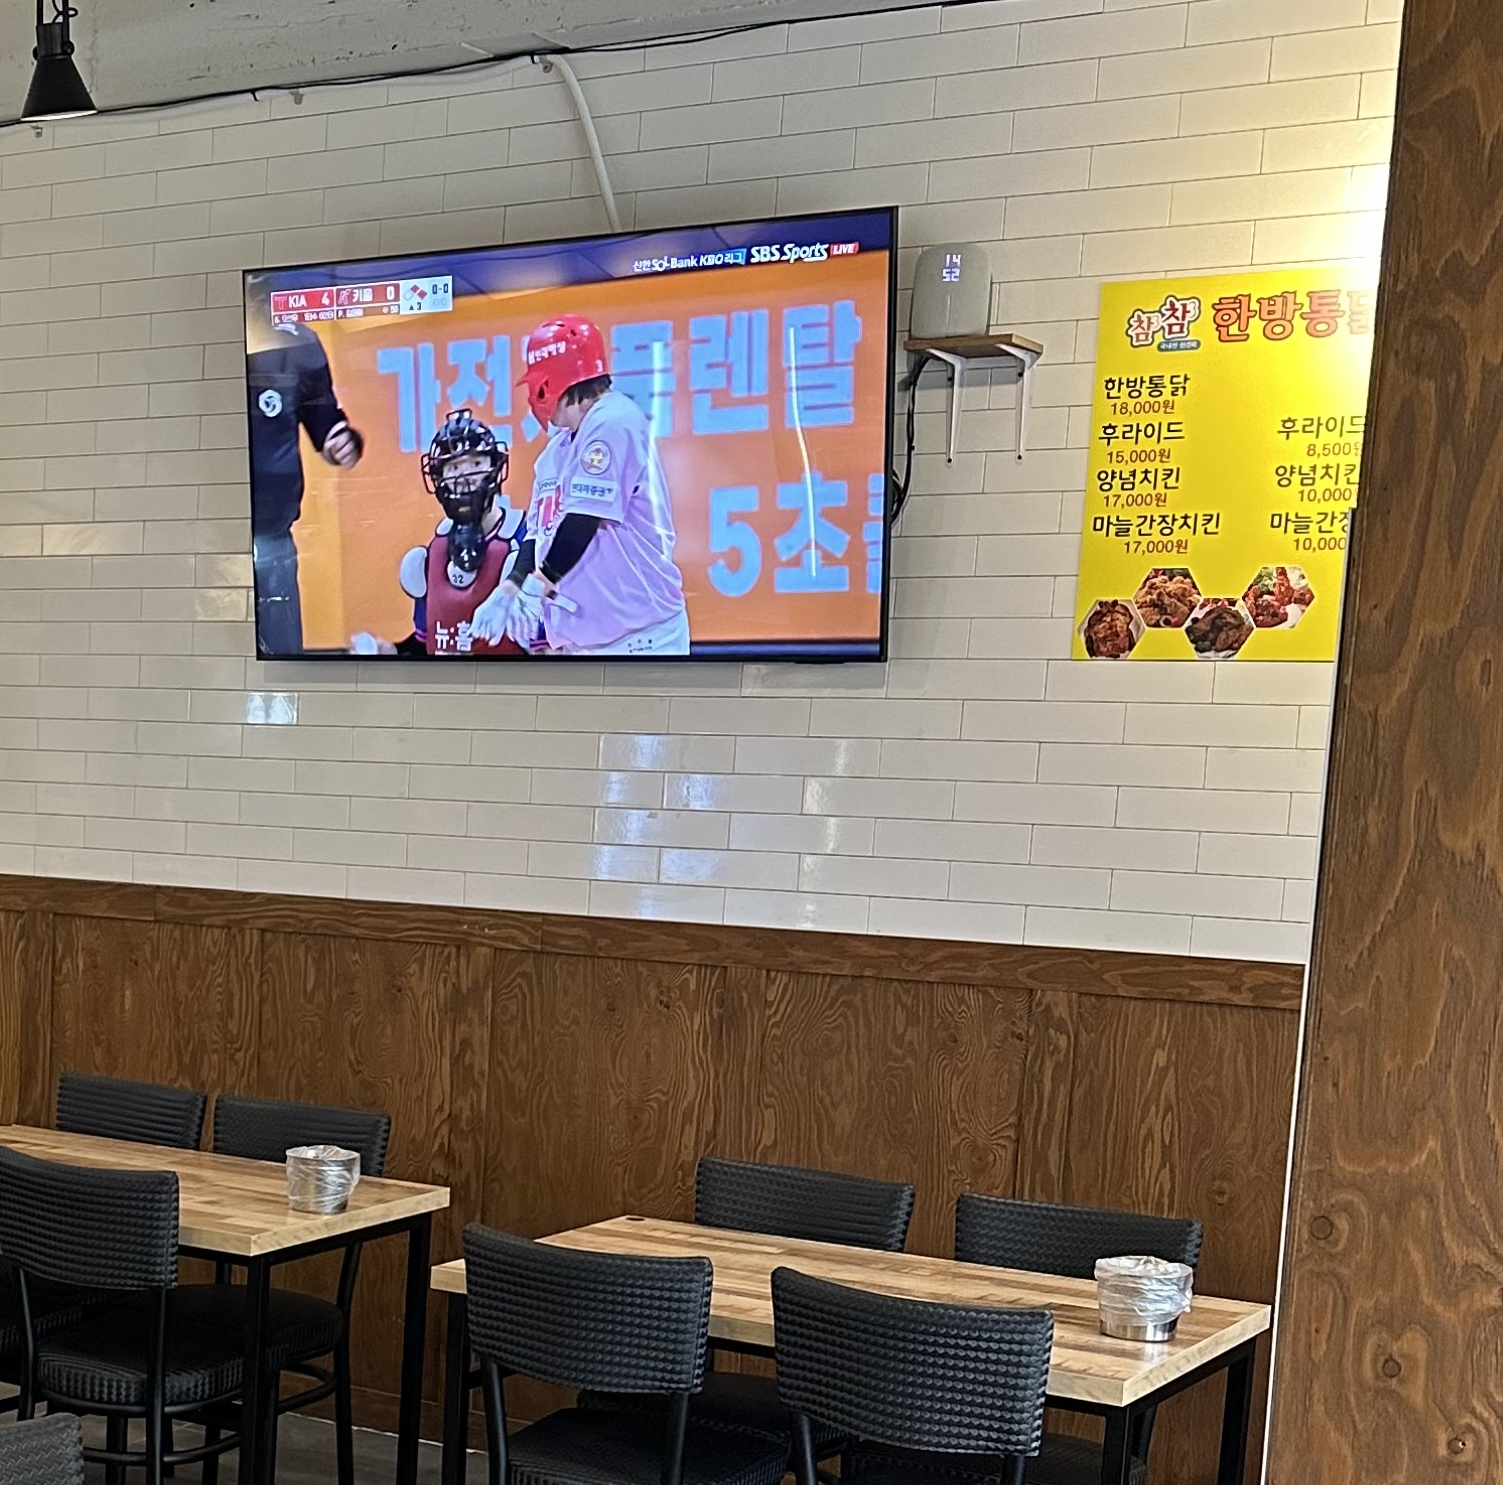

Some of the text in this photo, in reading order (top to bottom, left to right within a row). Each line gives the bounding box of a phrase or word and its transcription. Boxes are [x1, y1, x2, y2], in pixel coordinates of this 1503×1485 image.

[750, 246, 781, 263] SBS
[783, 242, 829, 263] Sports
[945, 254, 962, 268] 14
[942, 268, 961, 282] 52
[288, 295, 307, 308] KIA
[321, 293, 330, 306] 4
[386, 286, 395, 300] 0
[1103, 374, 1191, 400] 한방통닭
[1110, 399, 1175, 416] 18,000원
[1098, 421, 1186, 447] 후라이드
[1106, 448, 1171, 465] 15,000원
[1096, 467, 1181, 492] 양념치킨
[1103, 492, 1167, 509] 17,000원
[1298, 488, 1356, 504] 10,000
[1092, 512, 1221, 538] 마늘간장치킨
[708, 470, 884, 598] 5초
[1123, 539, 1189, 556] 17,000원
